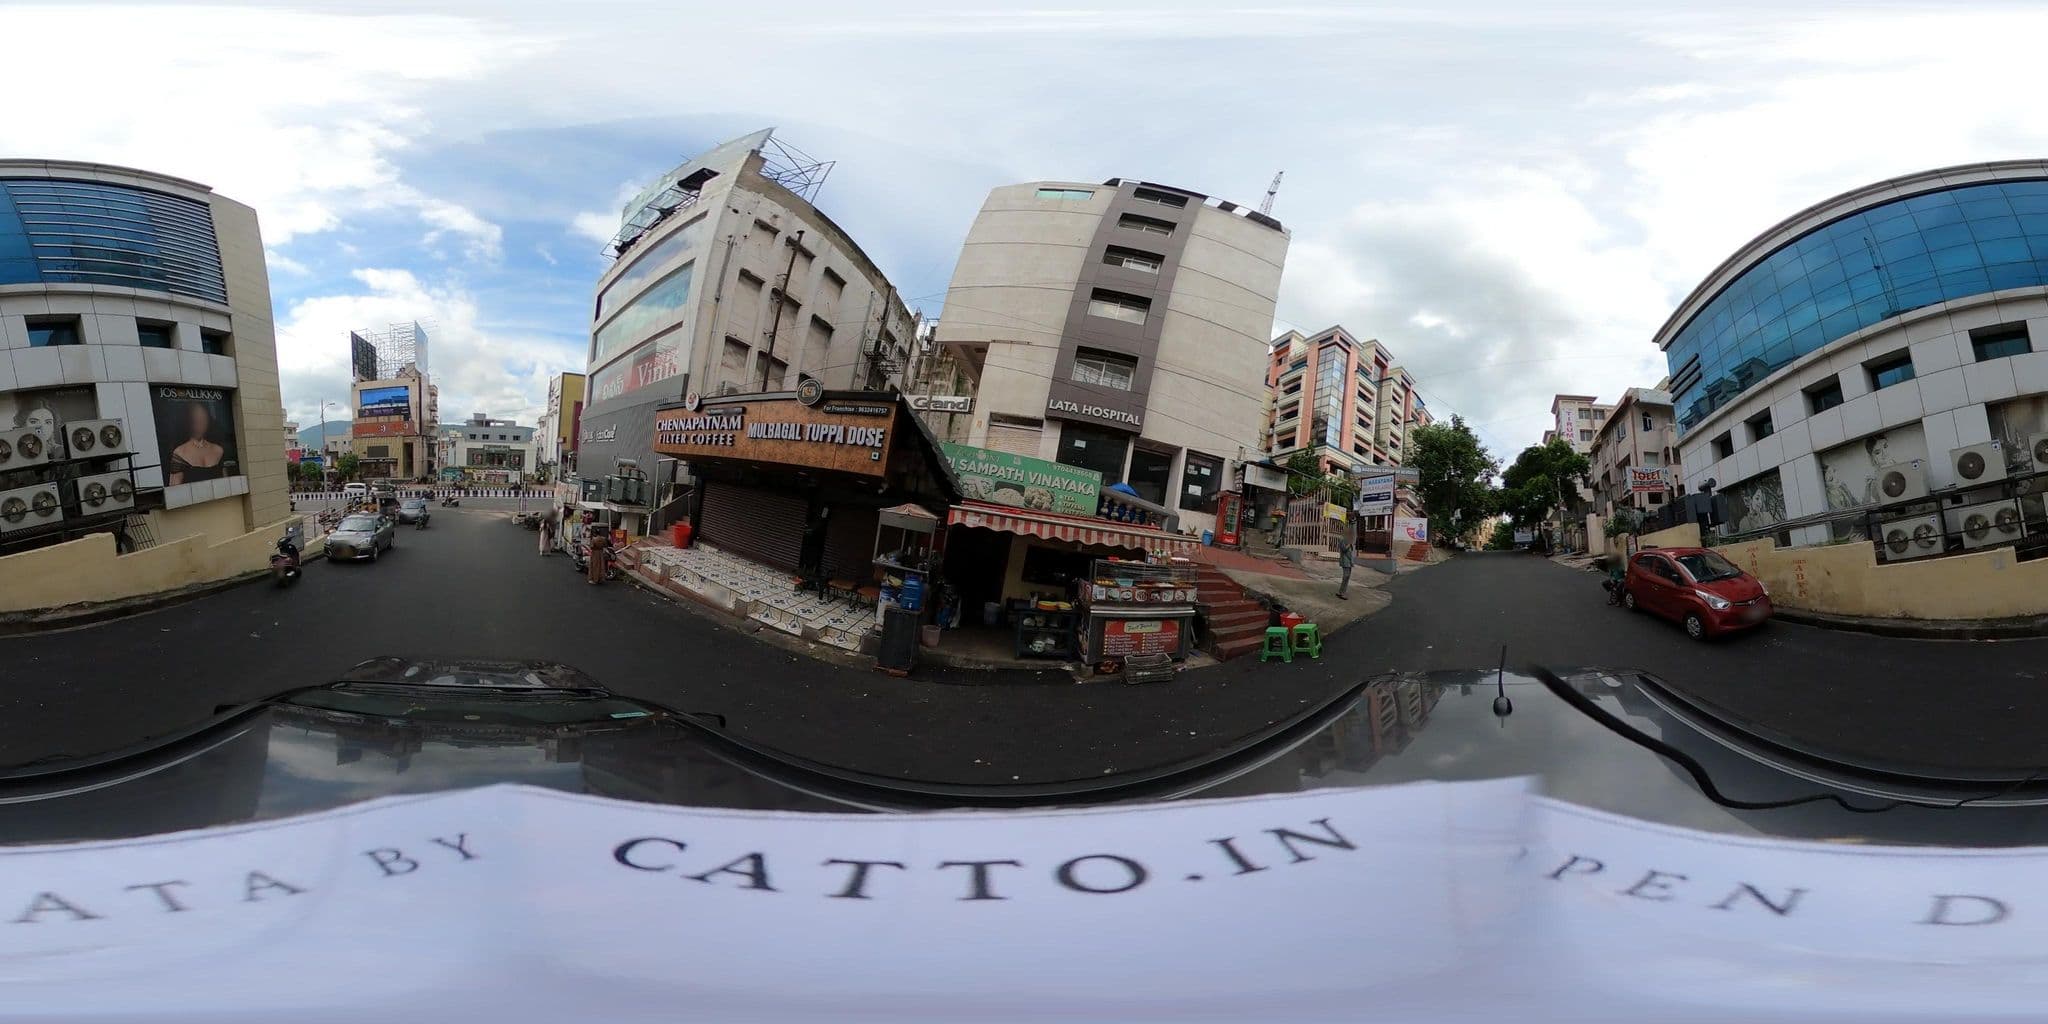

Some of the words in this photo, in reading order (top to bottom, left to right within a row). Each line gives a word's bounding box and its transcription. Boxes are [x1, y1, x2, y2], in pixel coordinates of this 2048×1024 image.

[913, 397, 969, 410] Gand
[1049, 399, 1079, 413] LATA
[1082, 404, 1141, 425] HOSPITAL
[656, 415, 742, 431] CHENNAPATNAM
[747, 422, 802, 440] MULBAGAL
[805, 423, 844, 444] TUPPA
[846, 426, 885, 447] DOSE
[659, 433, 687, 444] FILTER
[690, 433, 734, 445] COFFEE
[958, 459, 1025, 482] SAMPATH
[1027, 471, 1095, 497] VINAYAKA
[363, 832, 480, 878] BY
[612, 818, 1359, 902] CATTO.IN
